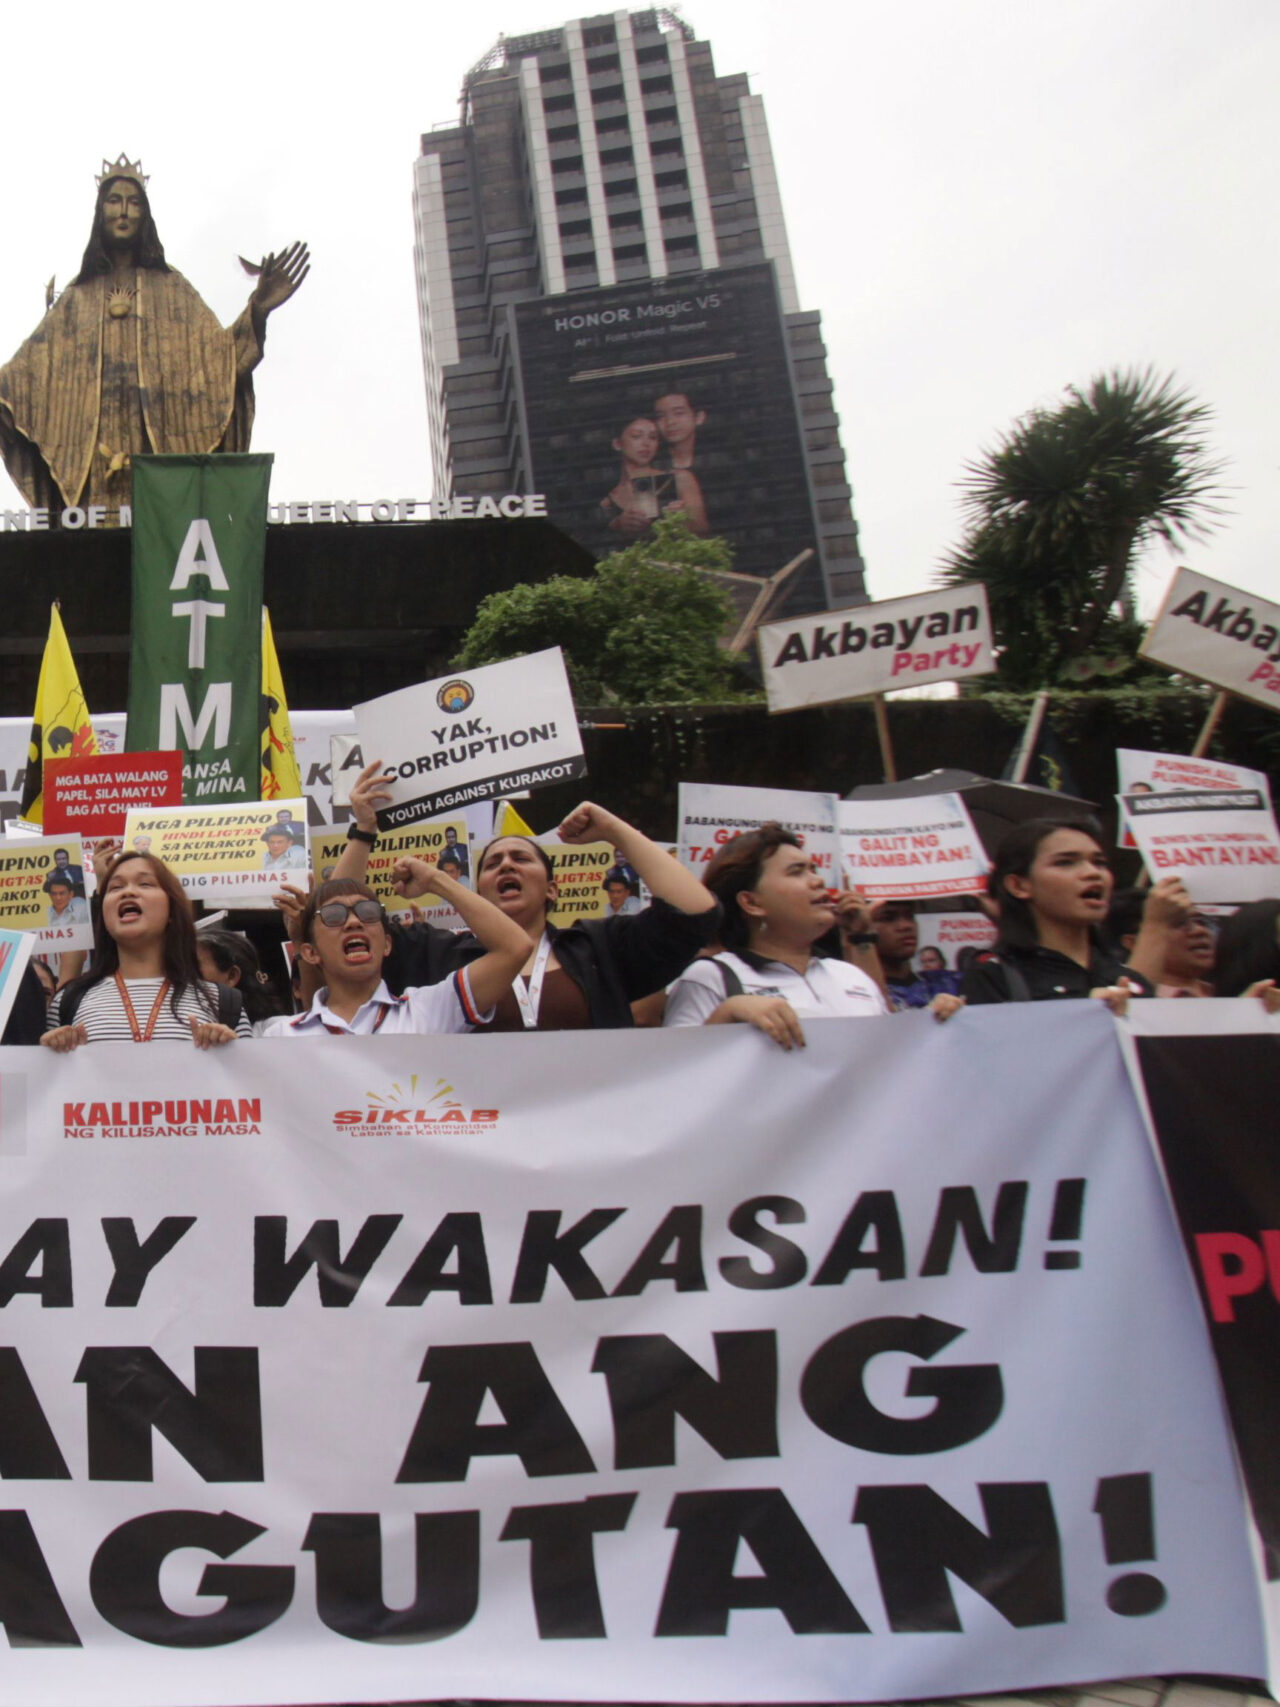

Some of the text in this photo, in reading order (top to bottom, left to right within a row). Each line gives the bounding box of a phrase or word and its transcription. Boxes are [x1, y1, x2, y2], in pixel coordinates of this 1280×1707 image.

[555, 293, 721, 331] HONOR Magic V5
[61, 505, 109, 530] OF
[267, 494, 547, 524] UEEN OF PEACE
[772, 605, 979, 668] Akbayan
[890, 642, 982, 677] Party
[431, 717, 492, 745] YAK,
[382, 721, 558, 784] CORRUPTION!
[55, 770, 168, 787] MGA BATA WALANG
[196, 776, 247, 798] MINA
[56, 785, 167, 802] PAPEL, SILA MAY LV
[386, 800, 433, 824] YOUTH
[435, 780, 497, 811] AGAINST
[498, 763, 574, 790] KURAKOT
[66, 805, 89, 816] BAG
[91, 804, 106, 814] AT
[136, 814, 272, 831] MGA PILIPINO
[786, 822, 835, 834] KAYO NG
[162, 827, 264, 841] HINDI LIGTAS
[371, 833, 442, 853] PILIPINO
[859, 834, 940, 852] GALIT NG
[161, 838, 257, 851] SA KURAKOT
[161, 849, 256, 863] NA PULITIKO
[848, 846, 971, 868] TAUMBAYAN!
[211, 872, 288, 885] PILIPINAS
[554, 871, 602, 884] LIGTAS
[63, 1098, 261, 1127] KALIPUNAN
[332, 1107, 499, 1125] SIKLAB
[64, 1124, 261, 1139] NG KILUSANG MASA
[336, 1124, 403, 1132] Simbahan
[423, 1122, 497, 1131] Komunidad
[253, 1178, 1087, 1309] WAKASAN!
[395, 1313, 1007, 1483] ANG
